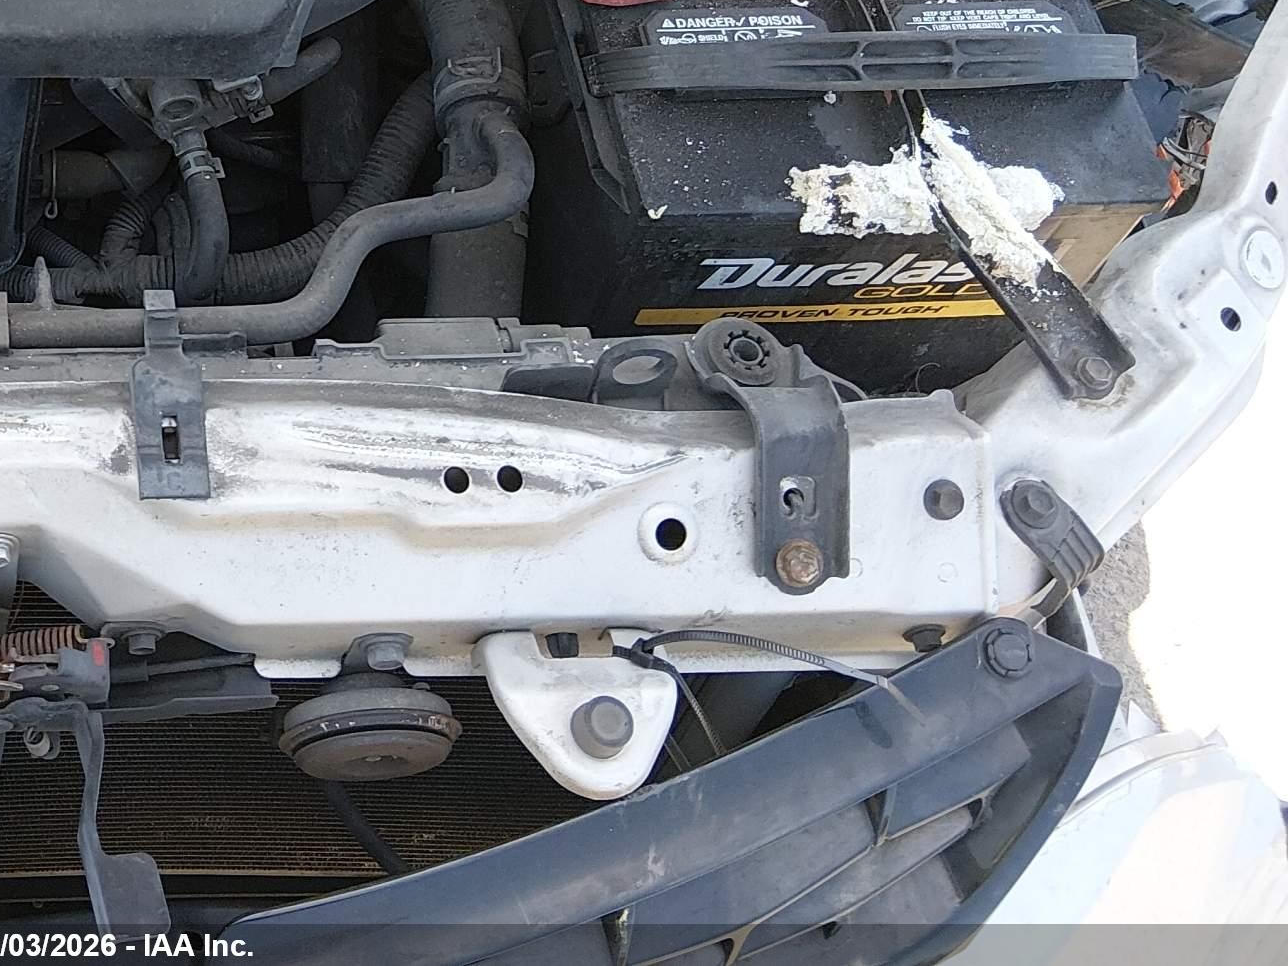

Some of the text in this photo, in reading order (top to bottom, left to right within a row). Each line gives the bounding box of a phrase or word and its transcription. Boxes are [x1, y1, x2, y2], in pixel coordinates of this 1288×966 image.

[749, 15, 803, 26] POISON
[697, 253, 975, 290] Duralas
[721, 305, 946, 319] PROVEN TOUGH
